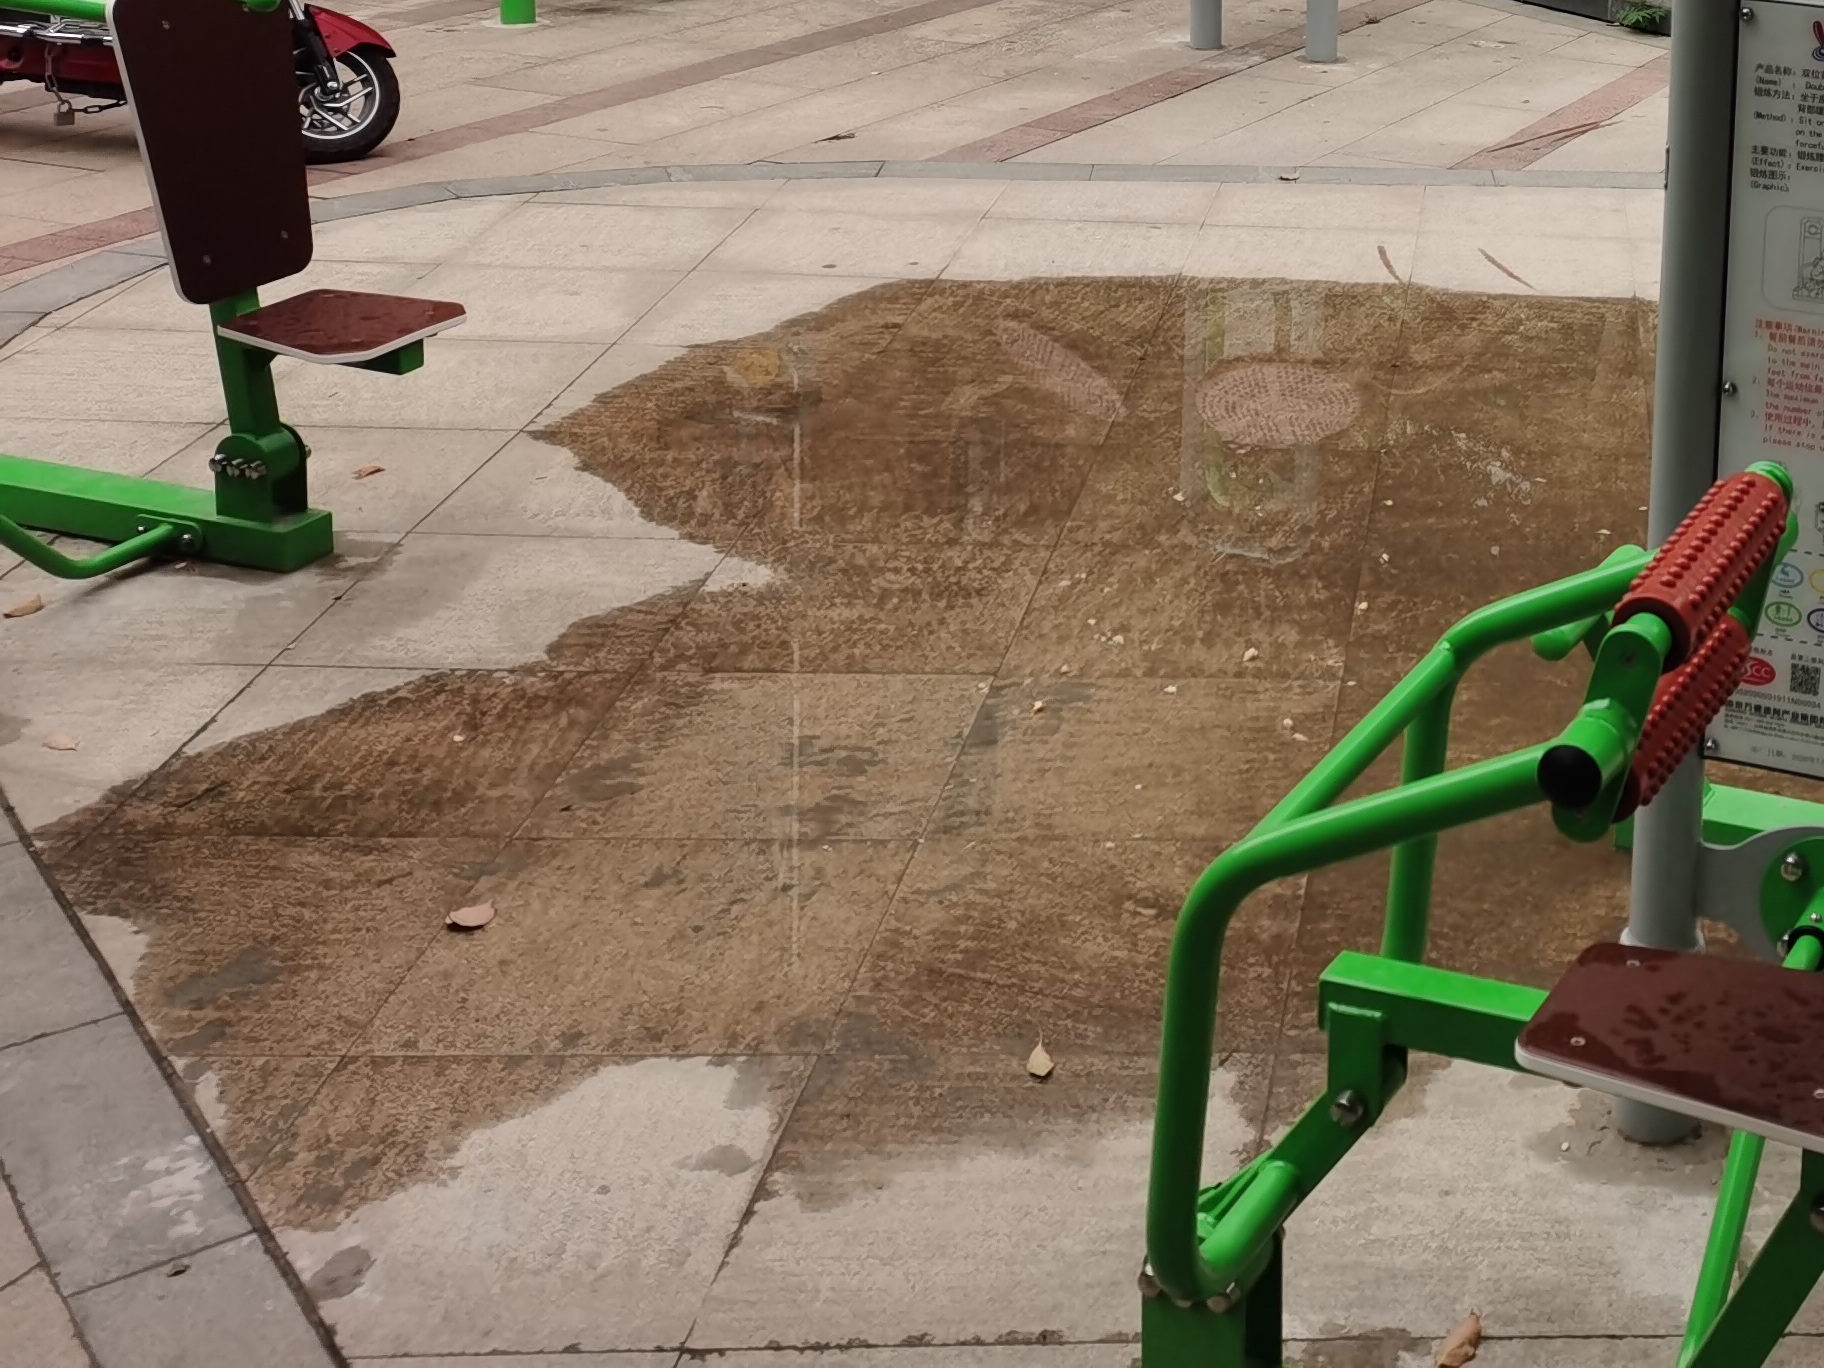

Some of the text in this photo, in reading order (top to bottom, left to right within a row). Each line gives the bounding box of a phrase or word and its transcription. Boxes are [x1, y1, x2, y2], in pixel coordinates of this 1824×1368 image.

[1798, 116, 1812, 126] Sit
[1809, 129, 1822, 138] the
[1767, 343, 1778, 353] Do
[1781, 346, 1796, 356] not
[1767, 356, 1777, 364] to
[1781, 358, 1796, 367] the
[1799, 361, 1819, 371] main
[1767, 367, 1785, 377] feet
[1791, 370, 1810, 381] from
[1765, 402, 1779, 410] the
[1782, 405, 1811, 415] number
[1777, 426, 1801, 437] there
[1806, 431, 1815, 439] is
[1762, 436, 1792, 447] please
[1795, 441, 1815, 451] stop
